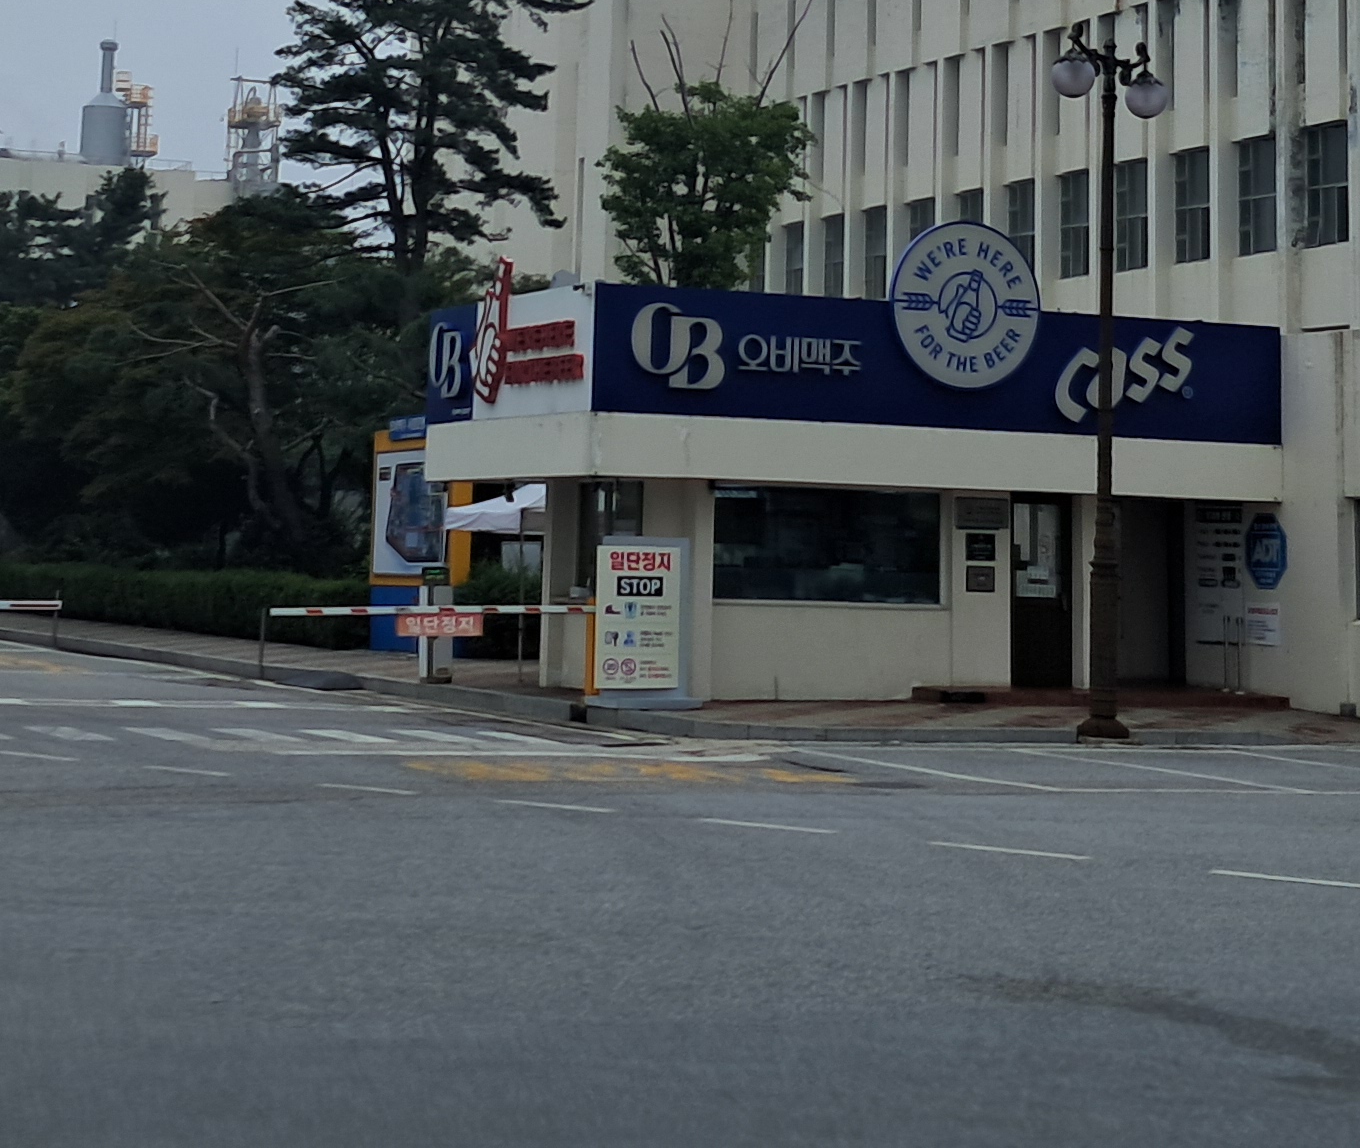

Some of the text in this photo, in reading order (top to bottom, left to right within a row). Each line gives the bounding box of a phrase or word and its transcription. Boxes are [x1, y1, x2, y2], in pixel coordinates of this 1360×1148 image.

[913, 238, 1023, 290] WE'RE HERE
[429, 321, 462, 399] OB
[631, 302, 726, 390] OB
[738, 333, 862, 376] 오비맥주
[914, 324, 1021, 373] FOR THE BEER
[609, 550, 671, 572] 일단정지
[619, 578, 661, 595] STOP
[405, 615, 475, 634] 일단정지
